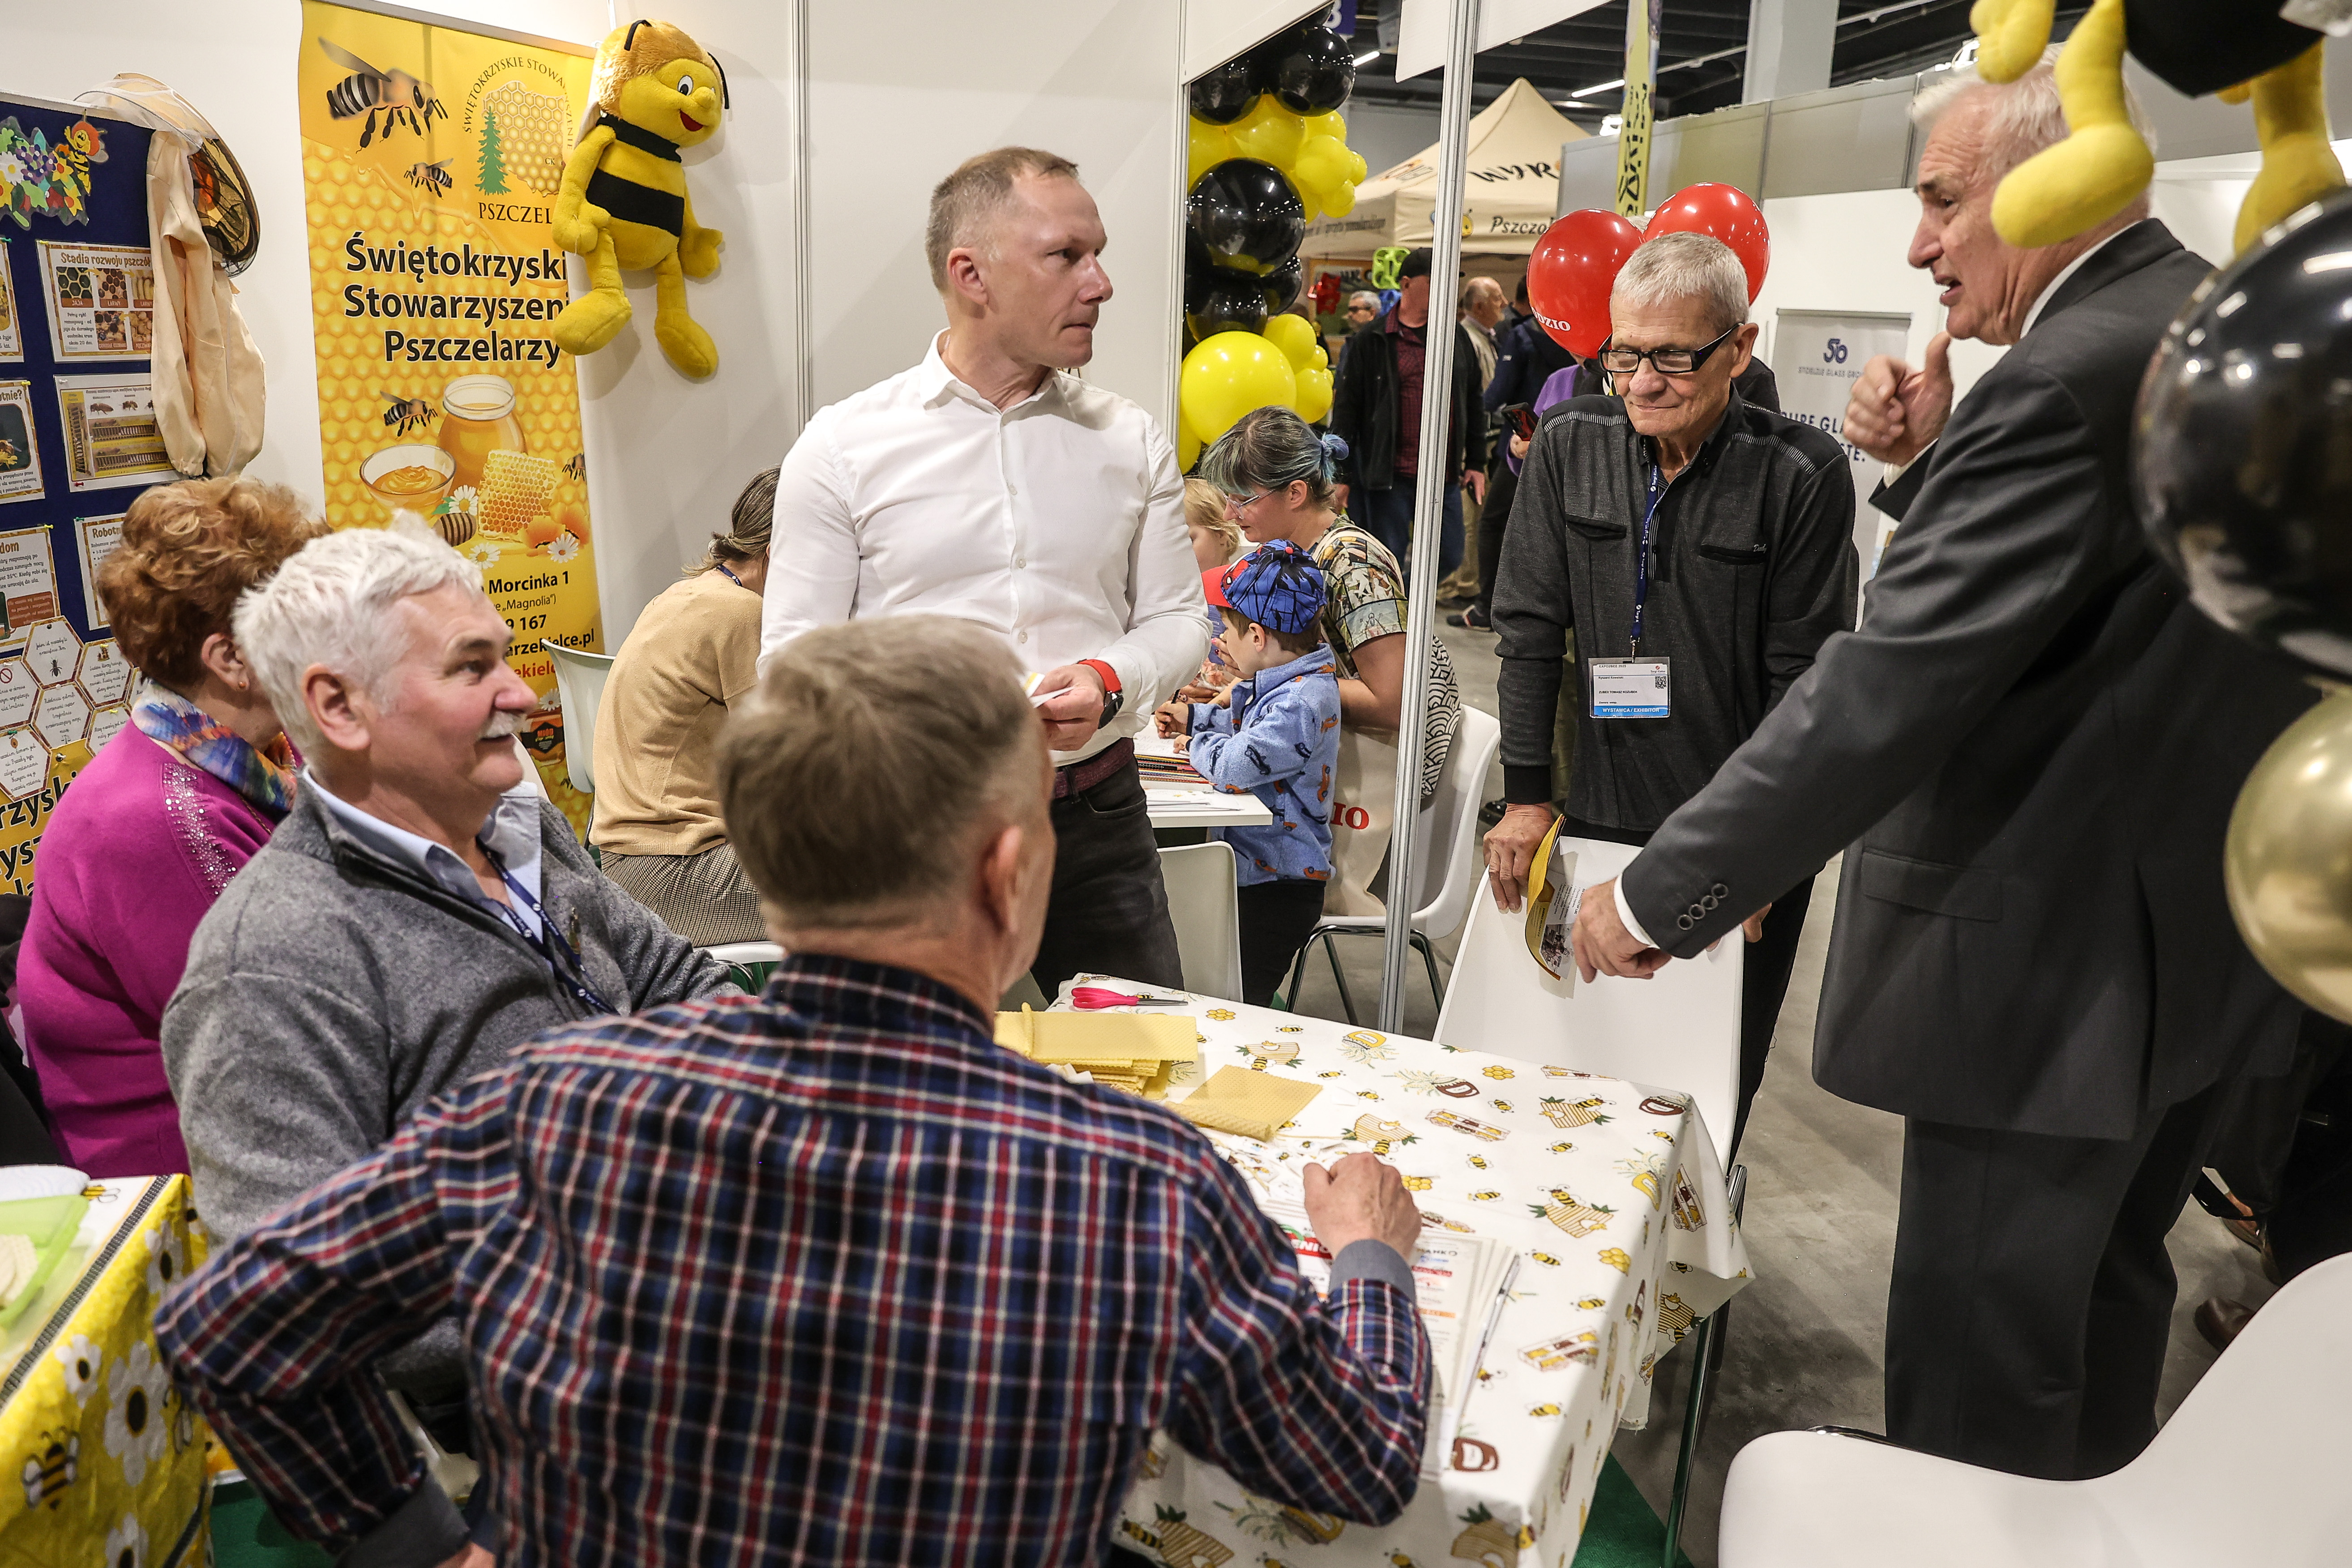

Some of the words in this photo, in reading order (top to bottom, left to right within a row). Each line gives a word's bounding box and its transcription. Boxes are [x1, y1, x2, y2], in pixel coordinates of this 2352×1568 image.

[462, 57, 524, 133] ŚWIĘTOKRZYSKIE
[60, 252, 89, 264] Stadia
[91, 255, 122, 267] rozwoju
[345, 231, 567, 286] Świętokrzyski
[385, 330, 560, 369] Pszczelarzy
[1820, 416, 1843, 434] GL
[489, 573, 558, 594] Morcinka
[563, 571, 569, 585] 1
[520, 614, 547, 630] 167
[1330, 802, 1370, 830] IO
